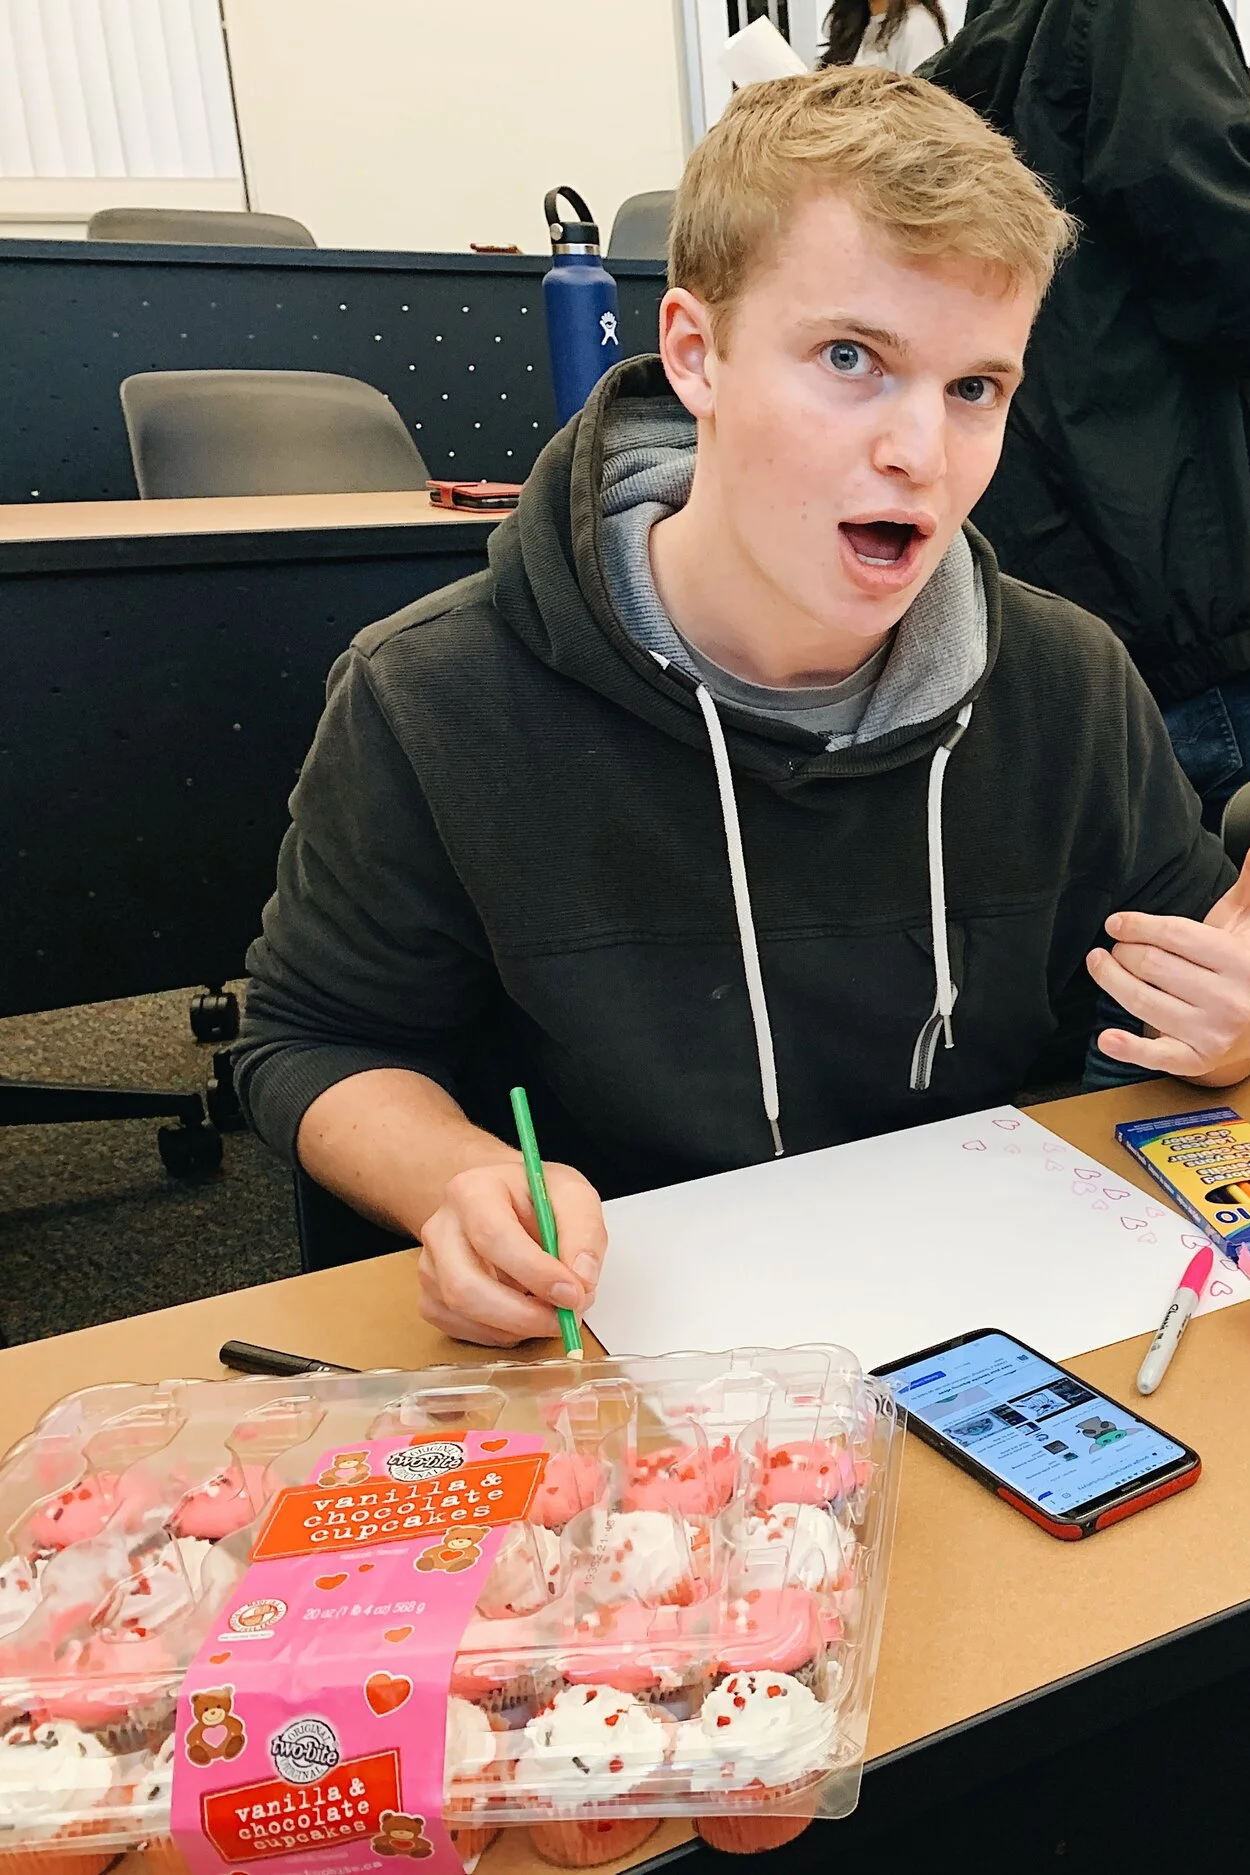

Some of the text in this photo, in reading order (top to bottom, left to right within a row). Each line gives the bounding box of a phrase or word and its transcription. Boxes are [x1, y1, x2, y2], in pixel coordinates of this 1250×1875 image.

[1206, 1129, 1231, 1137] de
[1168, 1147, 1232, 1163] couleur
[312, 1472, 503, 1512] vanilla &
[303, 1488, 505, 1529] chocolate
[310, 1504, 491, 1543] cupcakes
[303, 1608, 320, 1620] 20
[287, 1724, 334, 1744] ORIGINAL
[271, 1735, 340, 1767] two-bite
[234, 1777, 366, 1823] vanilla &
[238, 1799, 370, 1841] chocolate
[253, 1819, 367, 1851] cupcakes
